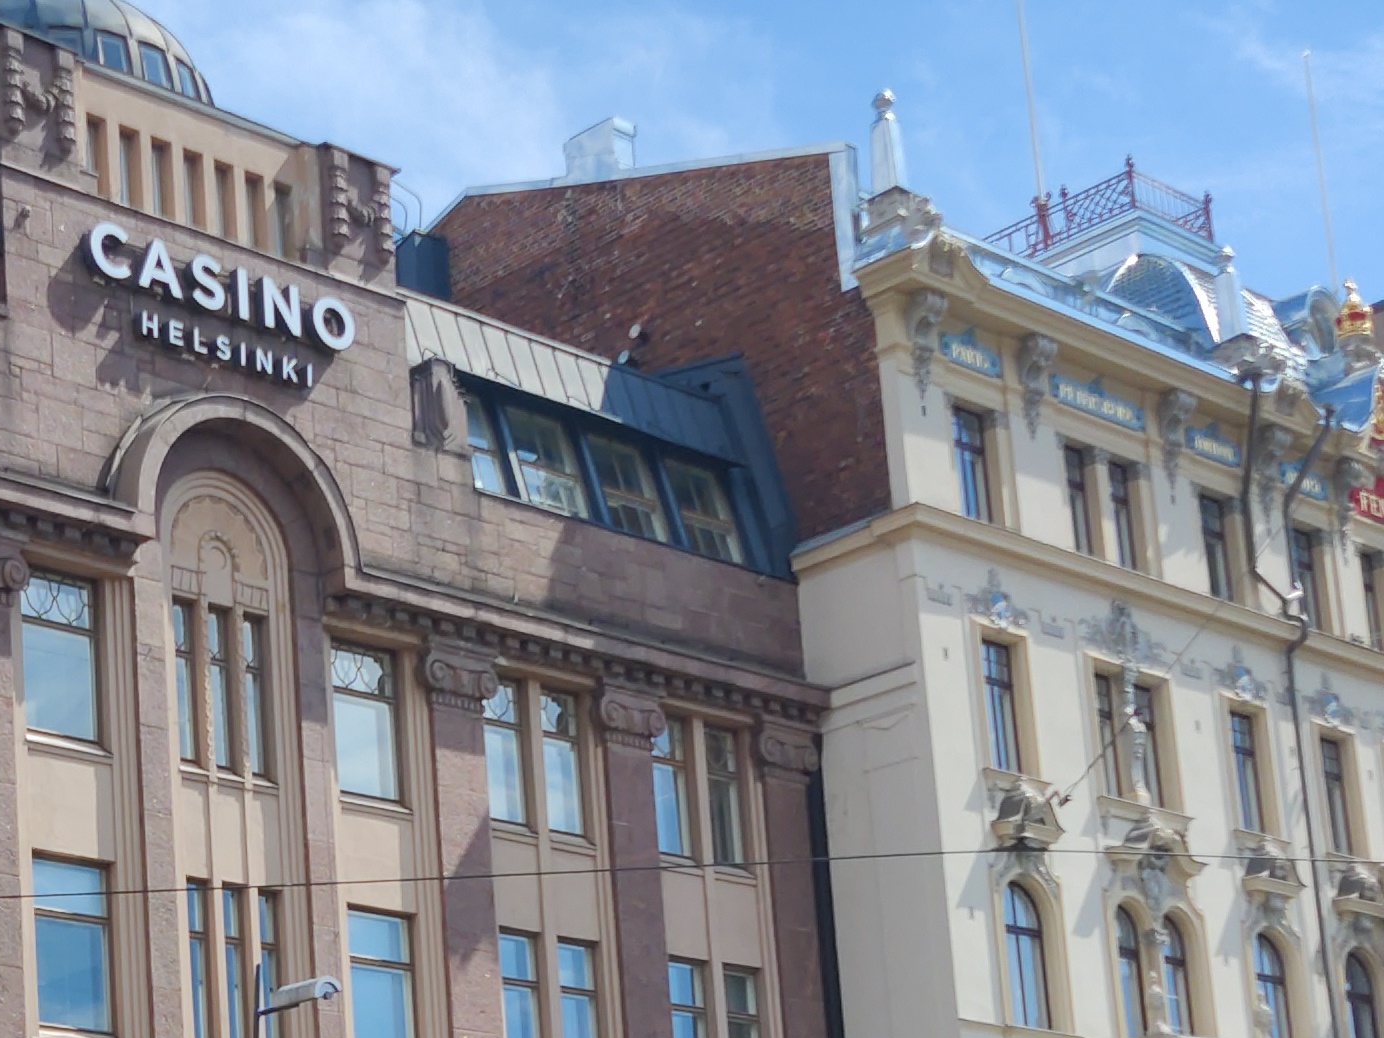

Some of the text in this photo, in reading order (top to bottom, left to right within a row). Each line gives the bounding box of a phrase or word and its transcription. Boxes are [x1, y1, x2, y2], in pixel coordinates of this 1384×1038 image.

[90, 221, 356, 351] CASINO
[141, 309, 314, 389] HELSINKI
[1359, 489, 1384, 519] FE
